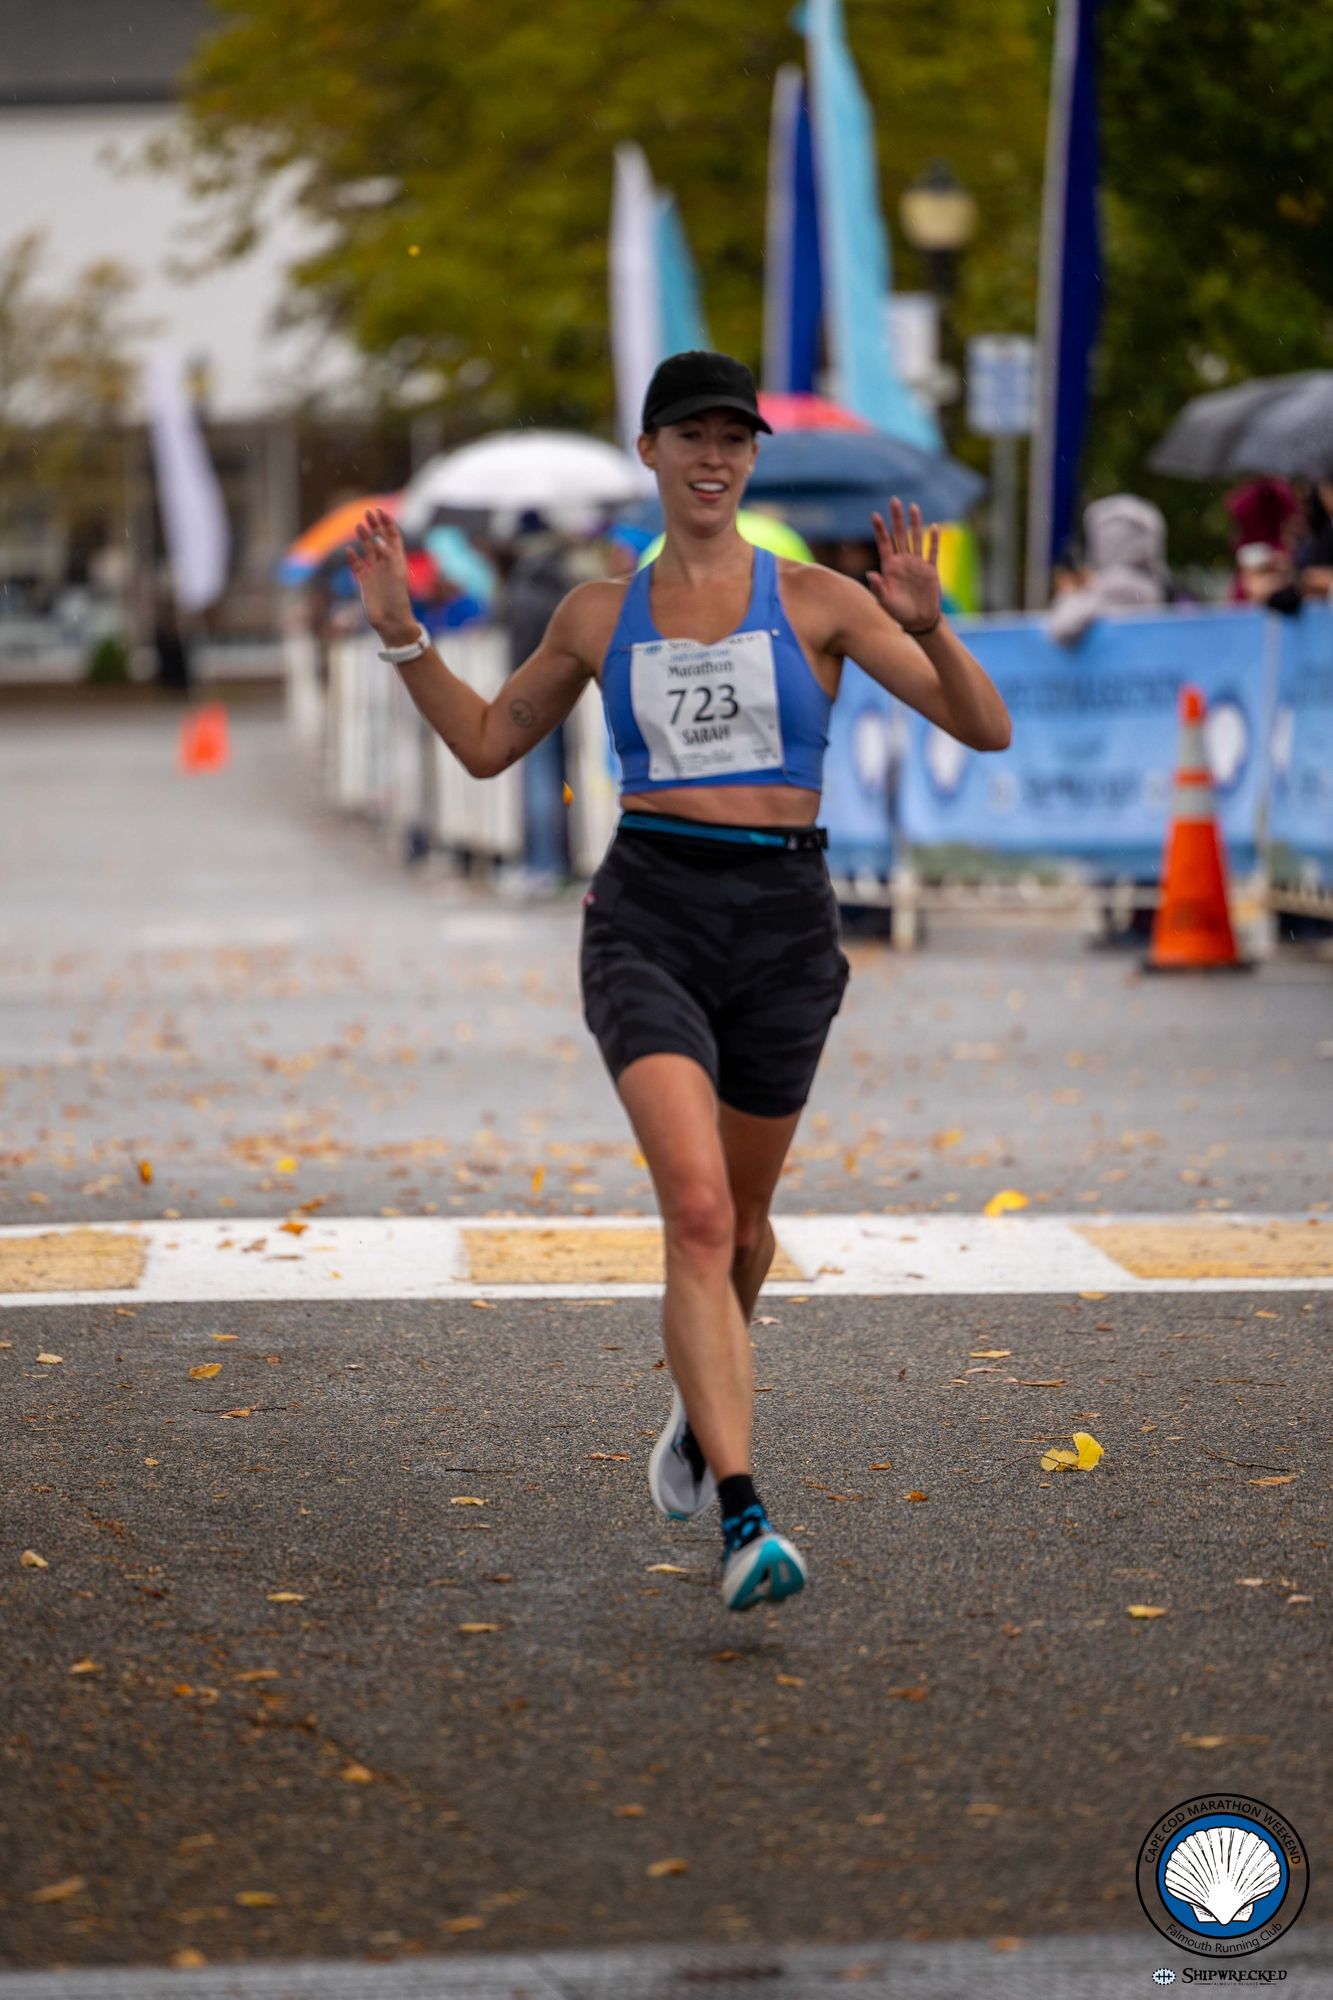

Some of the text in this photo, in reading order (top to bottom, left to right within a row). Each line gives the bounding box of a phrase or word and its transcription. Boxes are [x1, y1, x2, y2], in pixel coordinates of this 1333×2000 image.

[668, 660, 733, 678] Marathon
[666, 684, 740, 725] 723
[682, 725, 732, 746] SARAH
